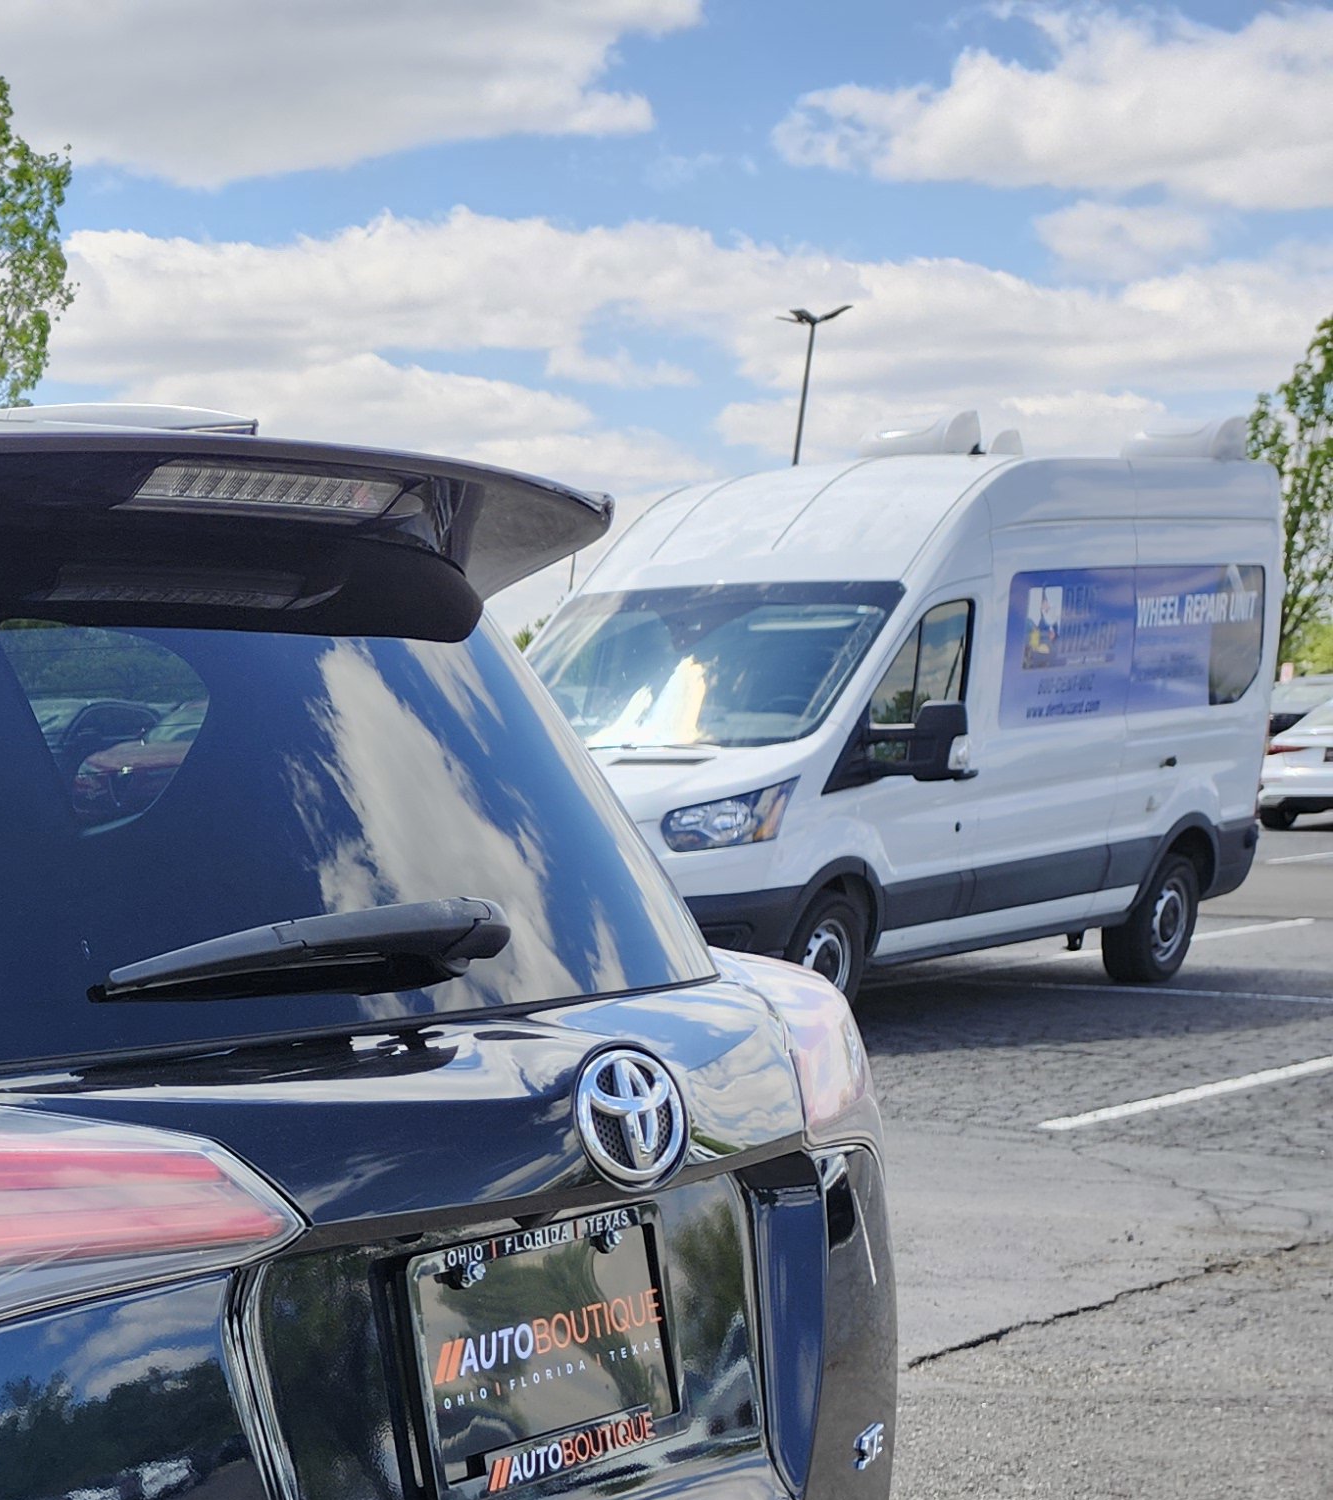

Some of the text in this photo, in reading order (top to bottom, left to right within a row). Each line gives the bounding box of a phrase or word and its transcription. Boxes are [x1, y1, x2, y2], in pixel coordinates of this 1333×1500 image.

[1136, 590, 1258, 628] WHEEL REPAIR UNIT
[1059, 620, 1117, 654] WIZARD
[447, 1211, 630, 1267] OHIO FLORIDA TEXAS
[444, 1338, 661, 1410] OHIO FLORIDA TEXAS
